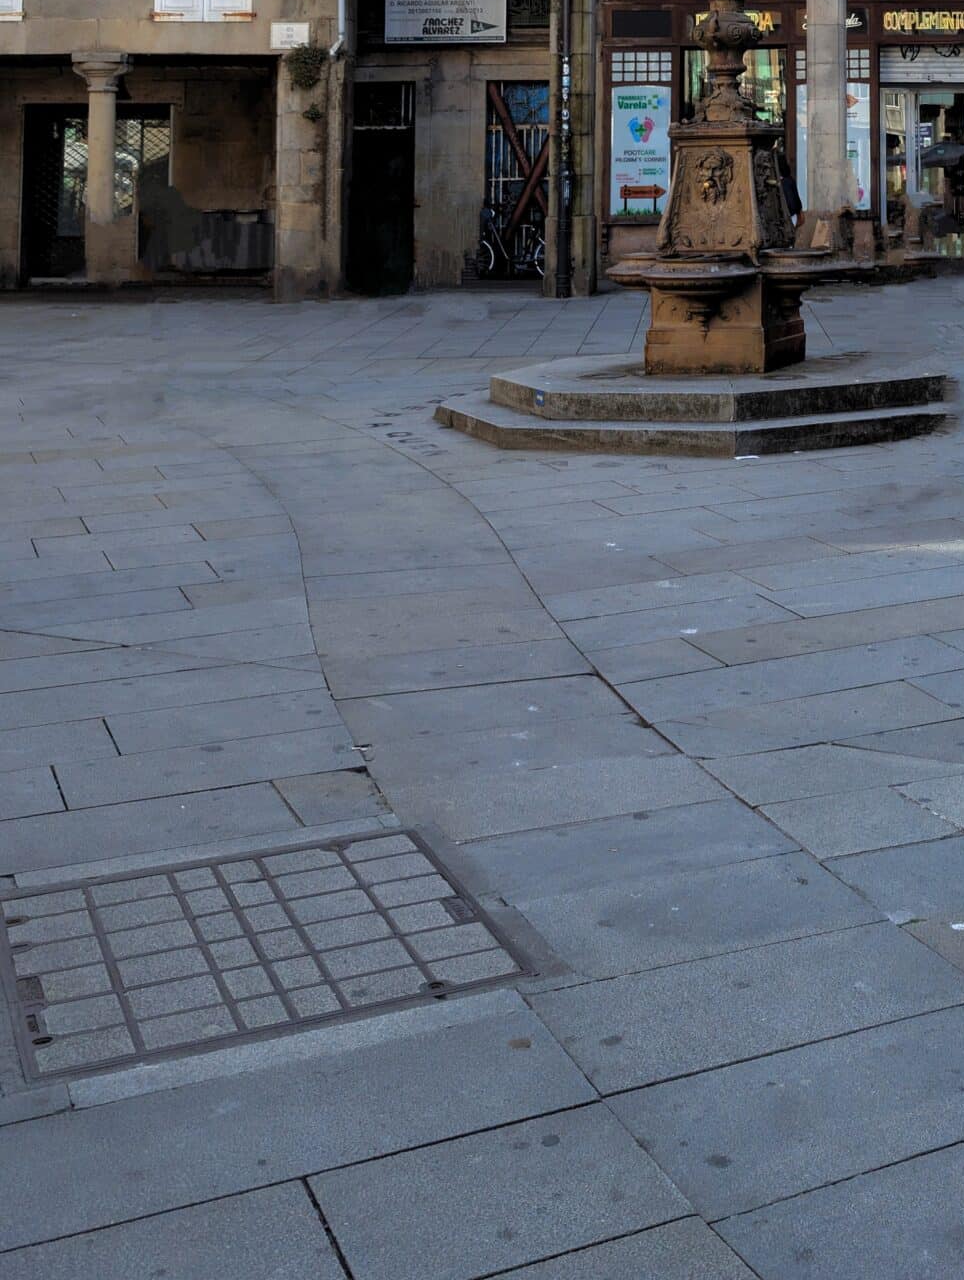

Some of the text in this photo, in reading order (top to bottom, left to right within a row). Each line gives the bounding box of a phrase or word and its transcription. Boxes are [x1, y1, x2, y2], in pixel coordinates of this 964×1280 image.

[423, 18, 465, 26] SANCHEZ
[422, 27, 460, 35] ALVAREZ
[618, 100, 648, 110] Varela
